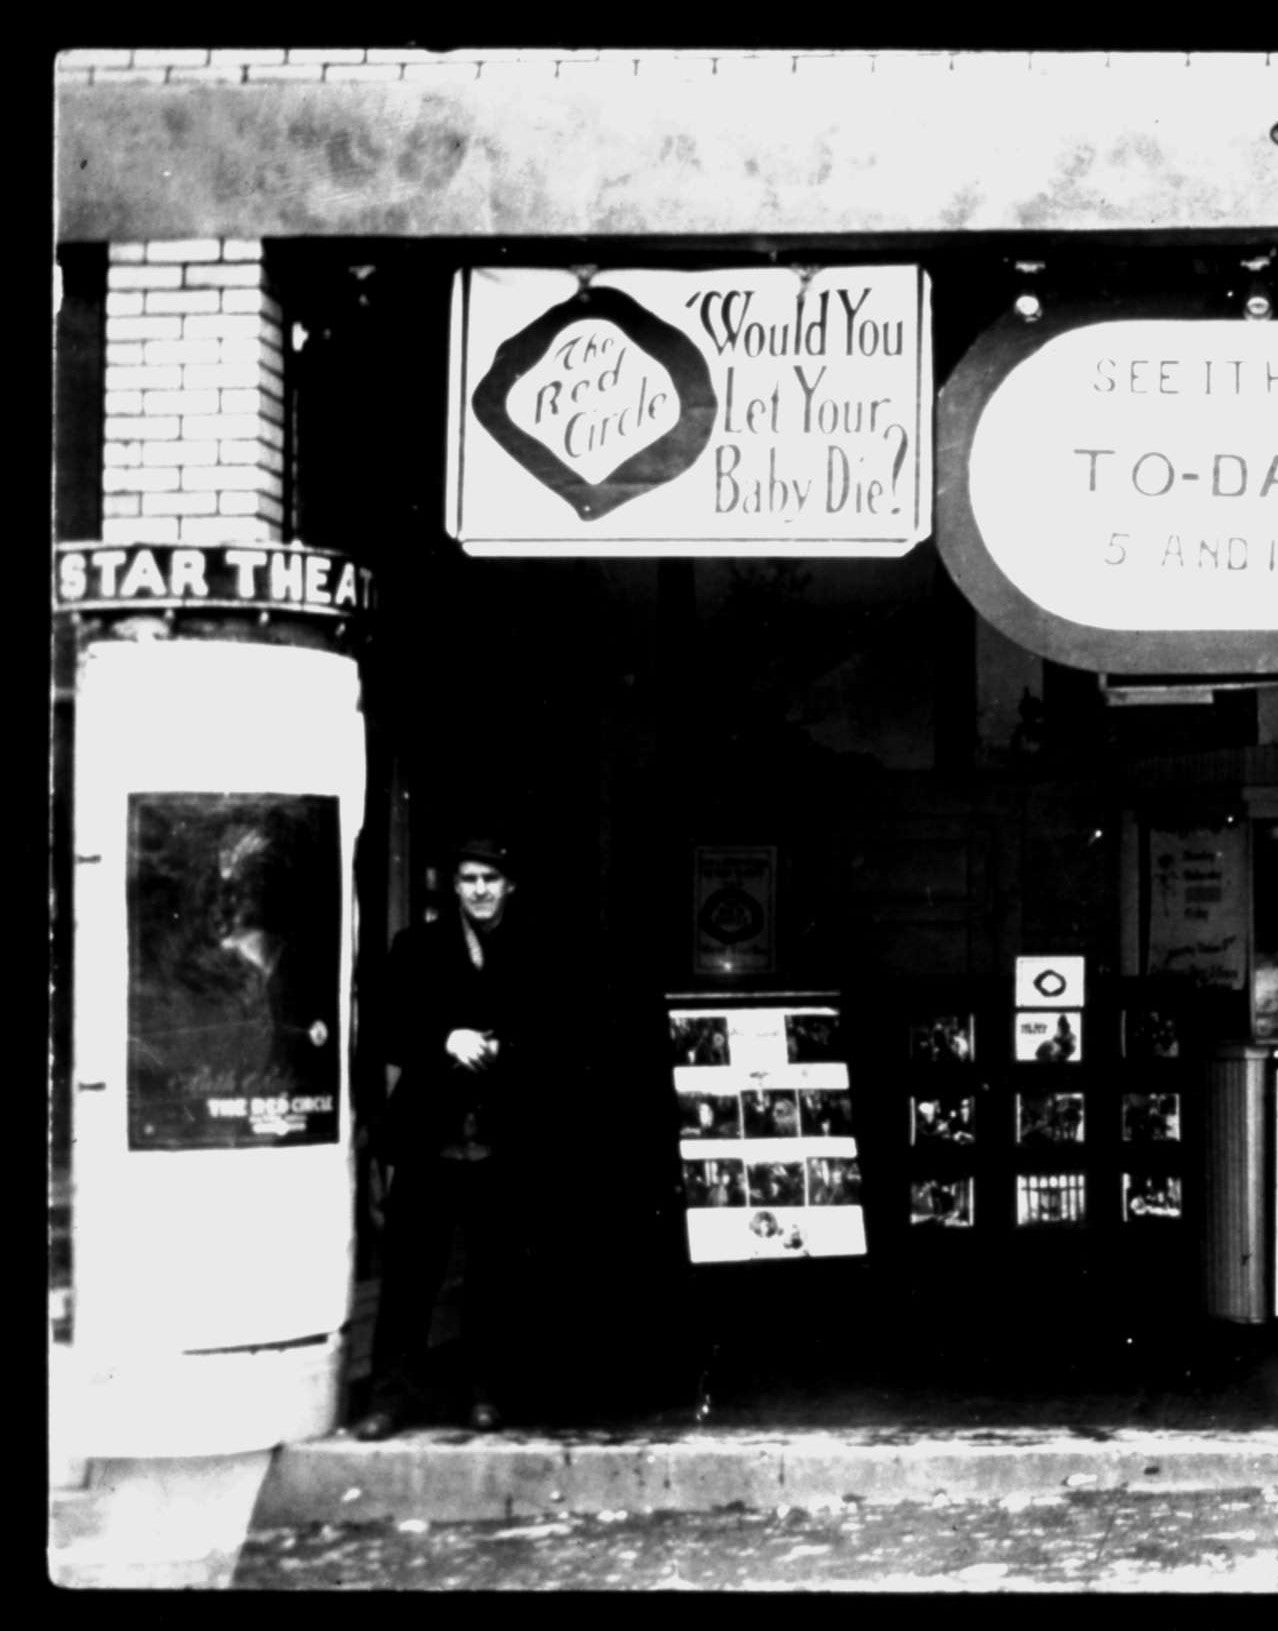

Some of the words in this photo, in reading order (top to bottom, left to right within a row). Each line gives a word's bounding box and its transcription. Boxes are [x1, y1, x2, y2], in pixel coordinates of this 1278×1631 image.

[555, 332, 615, 371] The
[837, 288, 904, 356] You
[534, 346, 627, 425] Red
[723, 366, 781, 435] Let
[793, 364, 892, 435] Your
[1094, 359, 1179, 394] SEE
[1204, 361, 1247, 395] IT
[563, 376, 669, 459] Circle
[714, 443, 812, 525] Baby
[824, 424, 909, 516] Die?
[59, 549, 209, 600] STAR
[224, 550, 378, 609] THEAT
[1103, 532, 1131, 567] 5
[1161, 534, 1249, 571] AND
